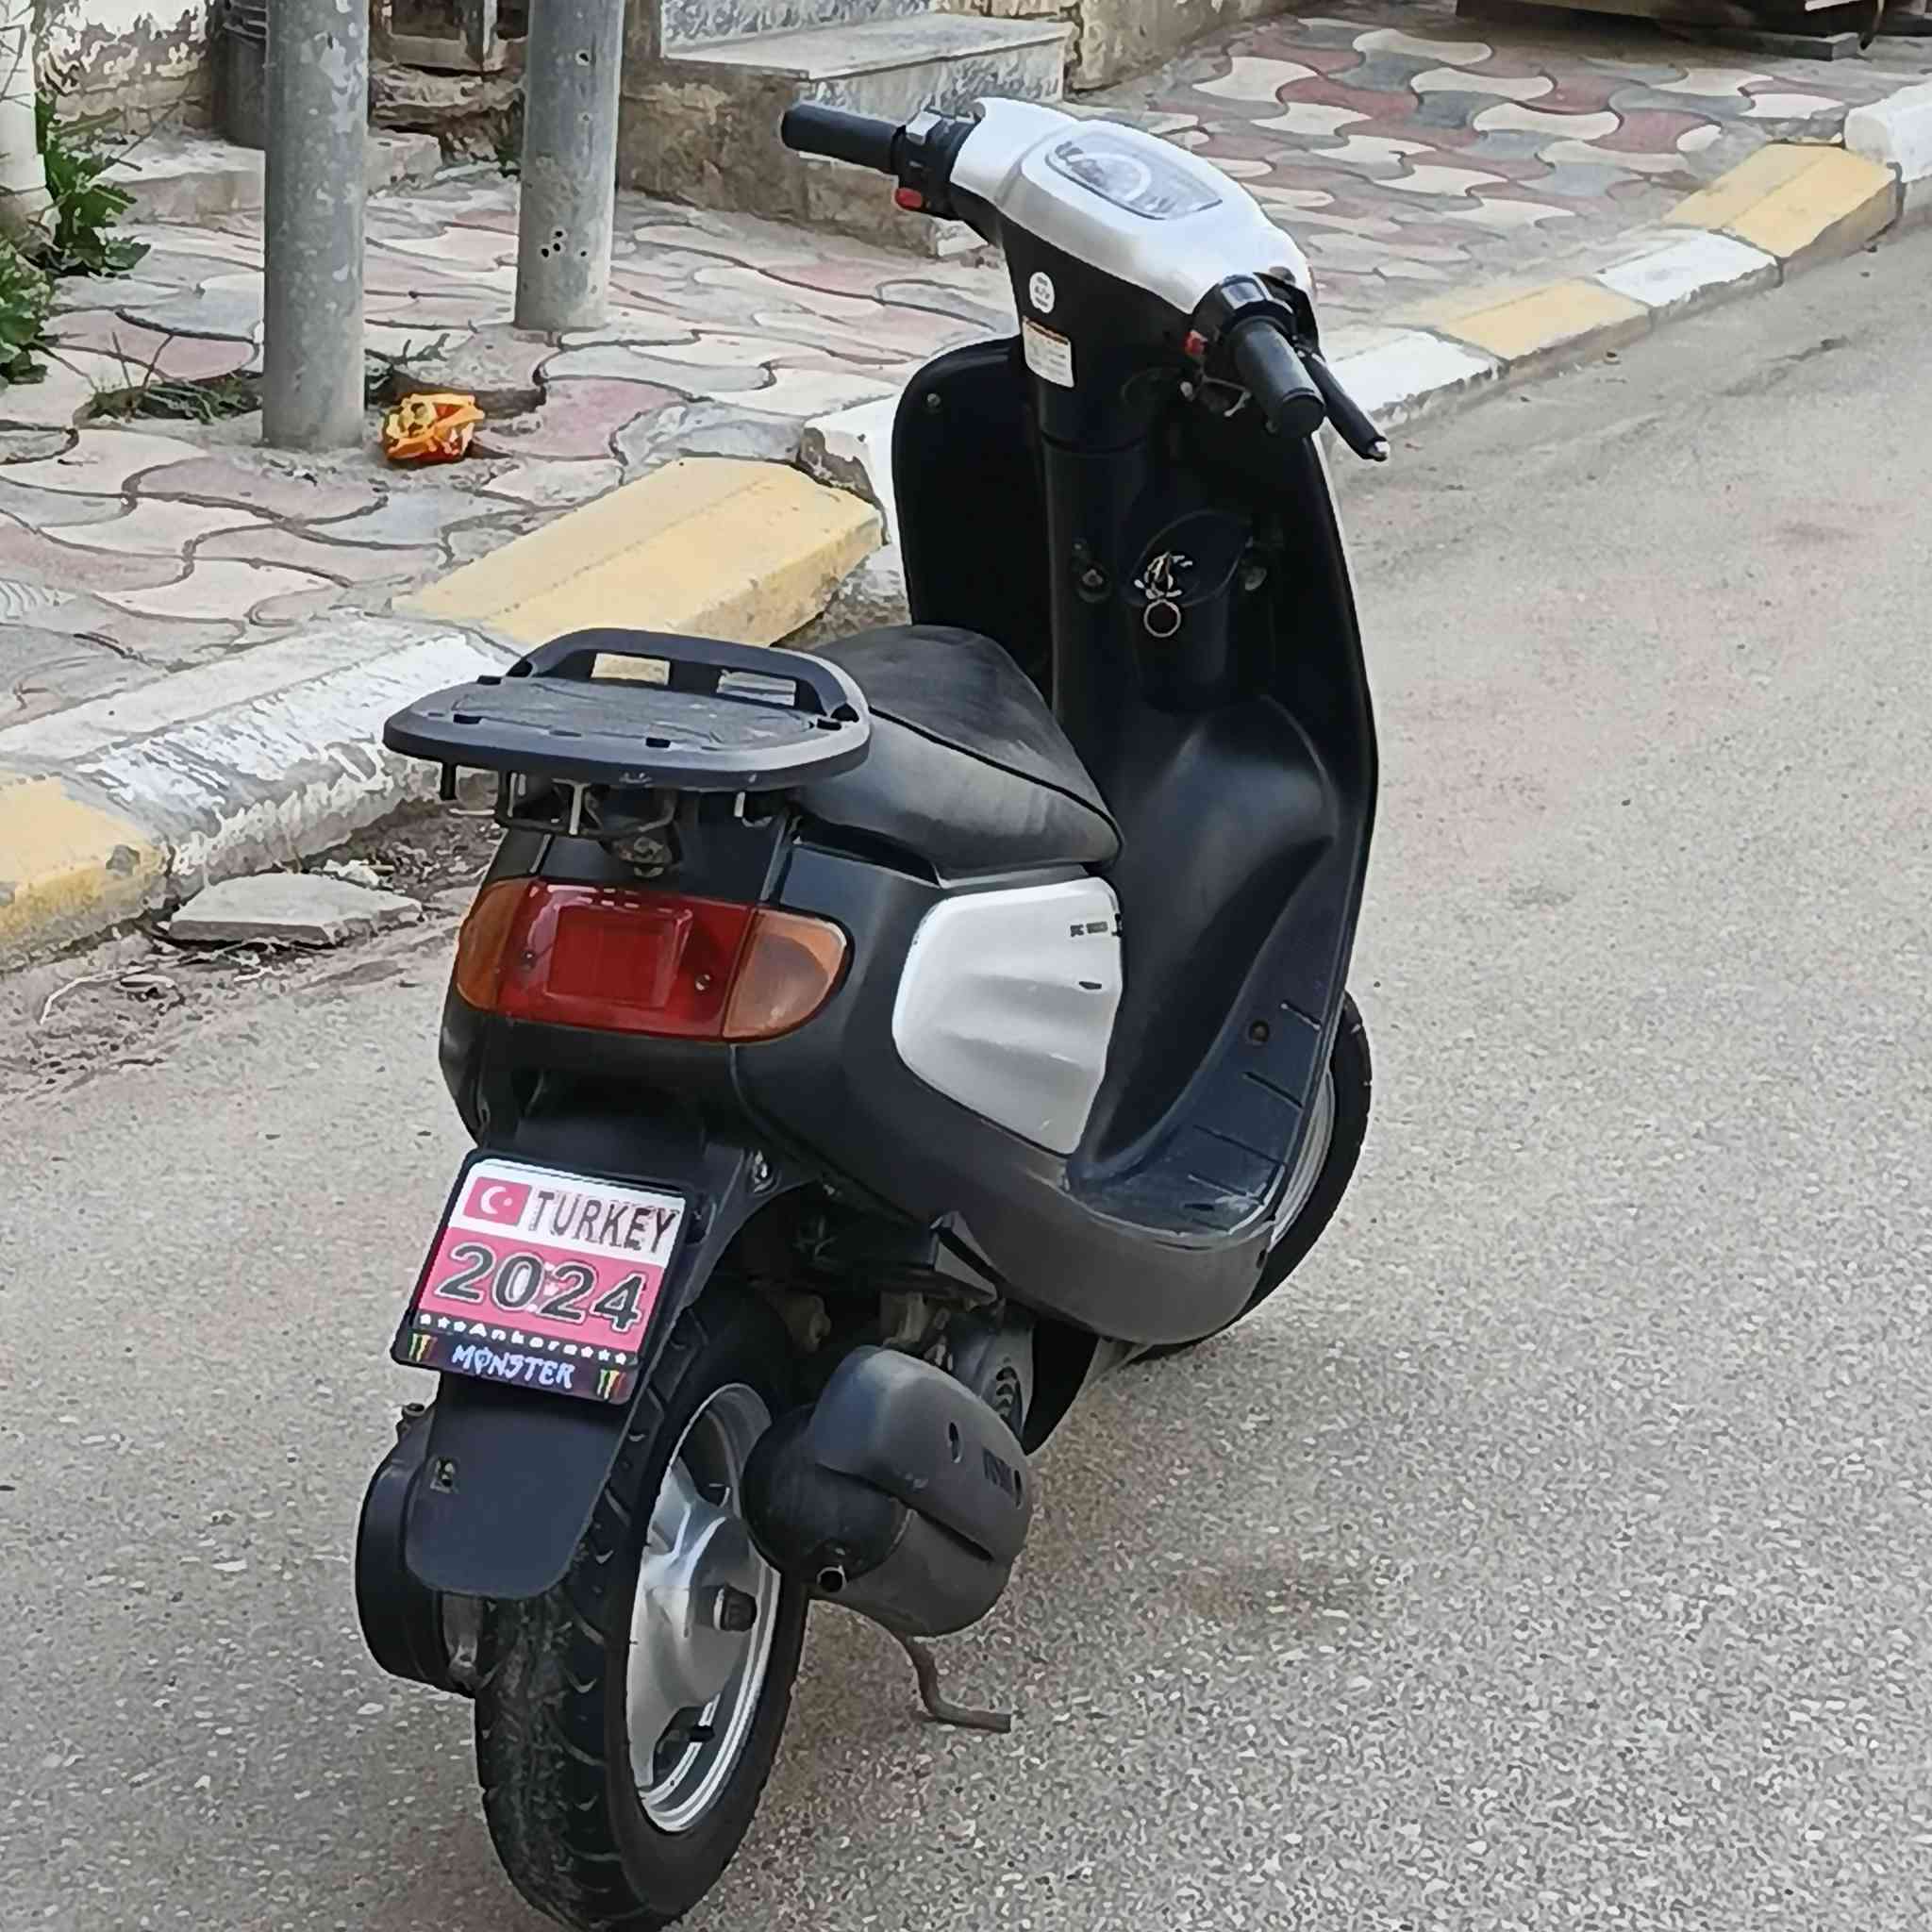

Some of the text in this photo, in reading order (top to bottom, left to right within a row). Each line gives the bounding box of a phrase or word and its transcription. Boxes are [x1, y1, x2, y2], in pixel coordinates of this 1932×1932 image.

[528, 1190, 681, 1253] TURKEY
[435, 1242, 647, 1332] 2024
[452, 1344, 575, 1389] MONSTER
